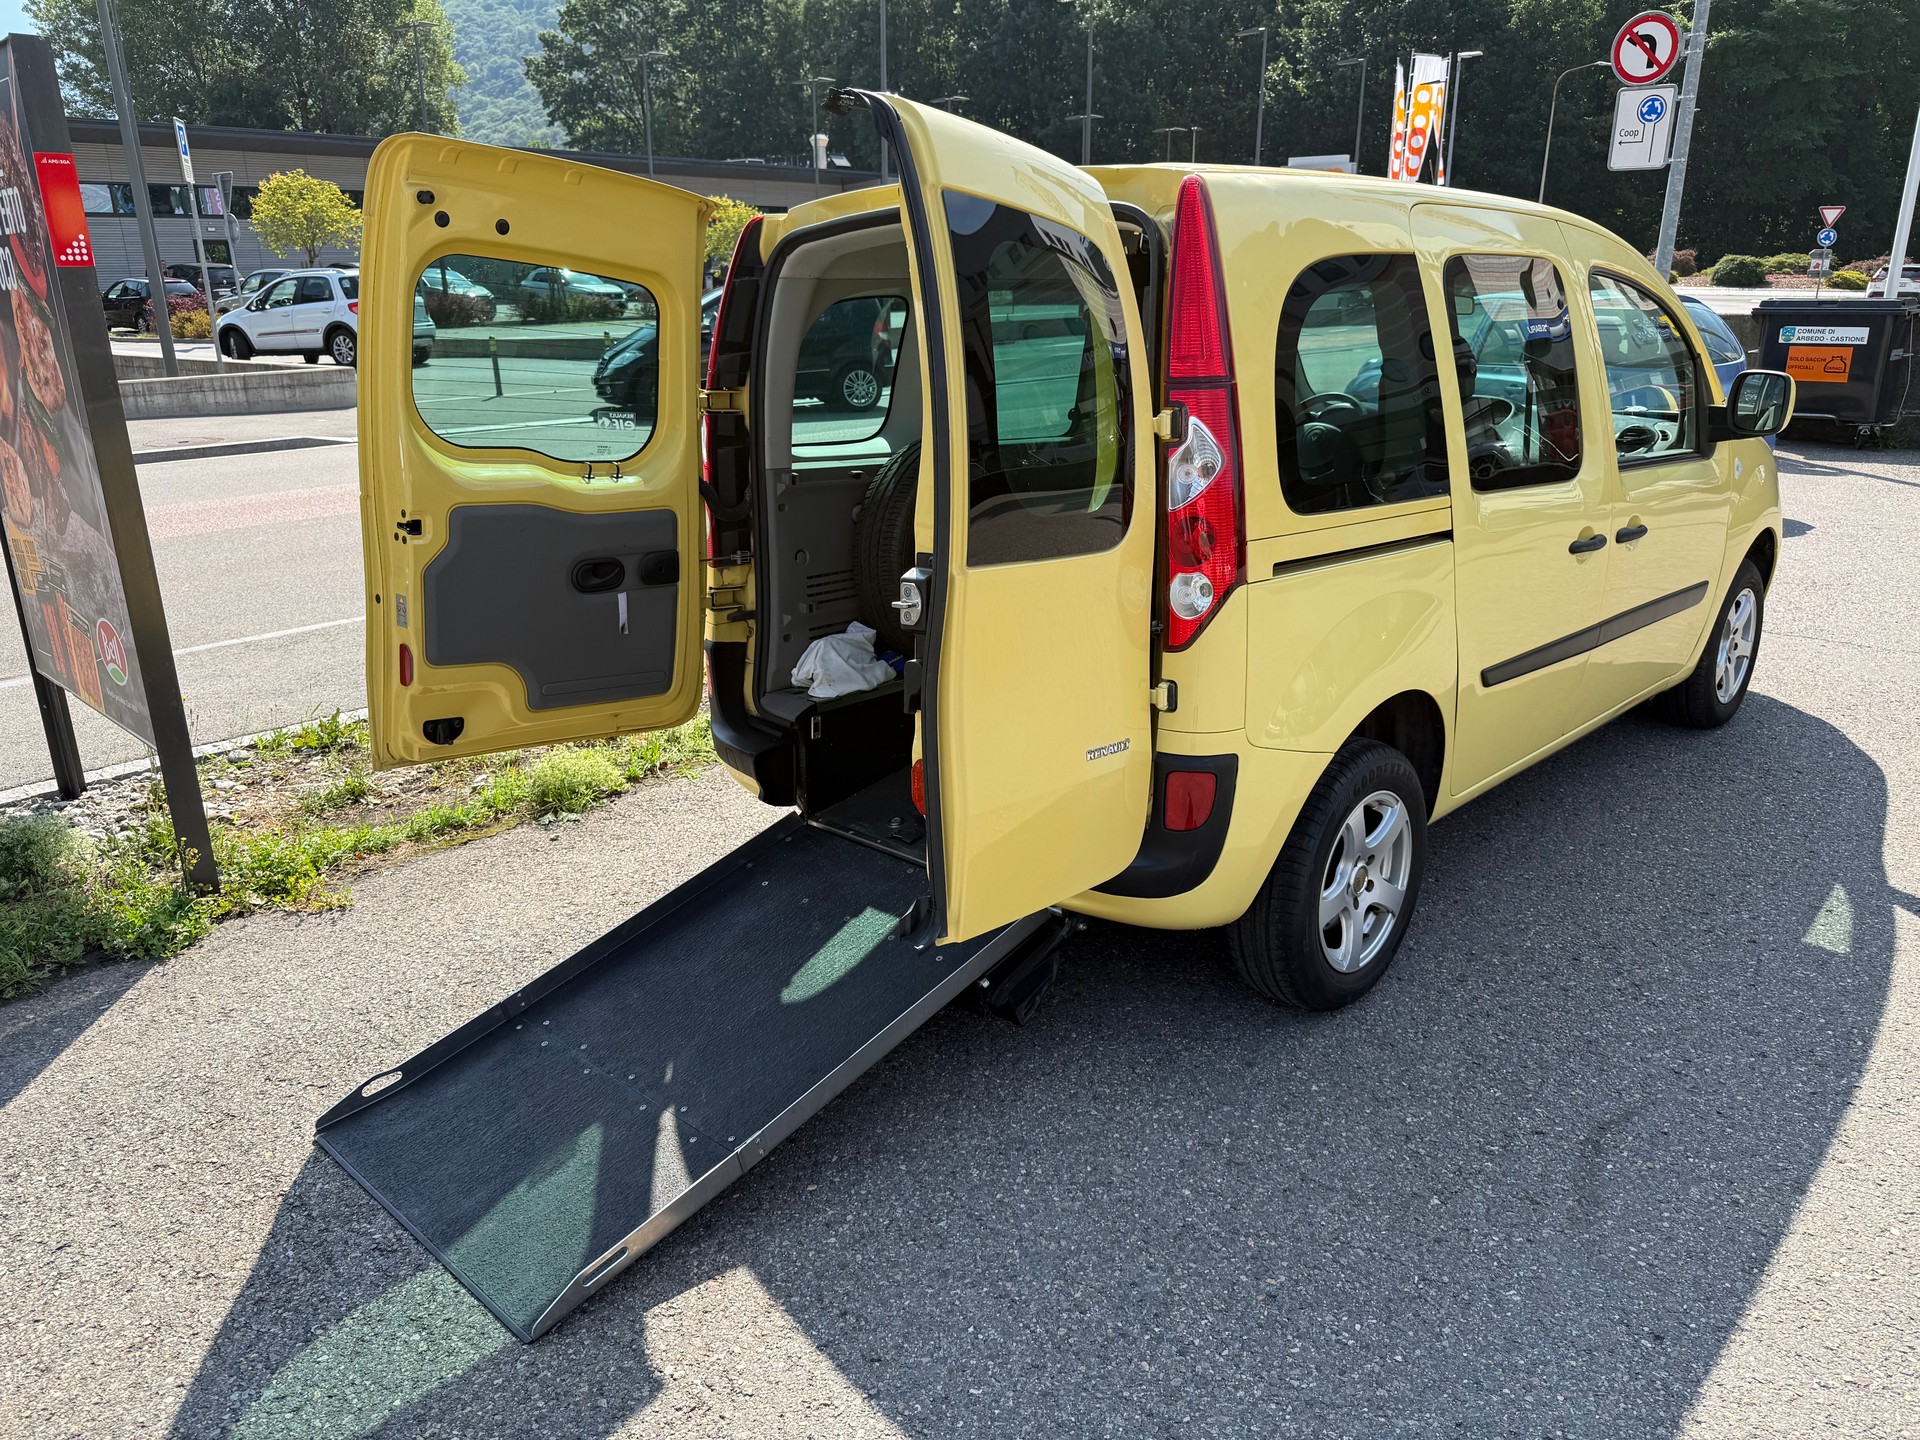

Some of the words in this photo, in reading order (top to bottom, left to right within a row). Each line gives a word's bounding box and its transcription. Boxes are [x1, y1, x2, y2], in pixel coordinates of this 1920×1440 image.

[1619, 128, 1640, 139] Coop
[100, 628, 122, 670] Bell
[1085, 737, 1131, 762] RENAULT
[1353, 762, 1415, 798] GOODYEAR
